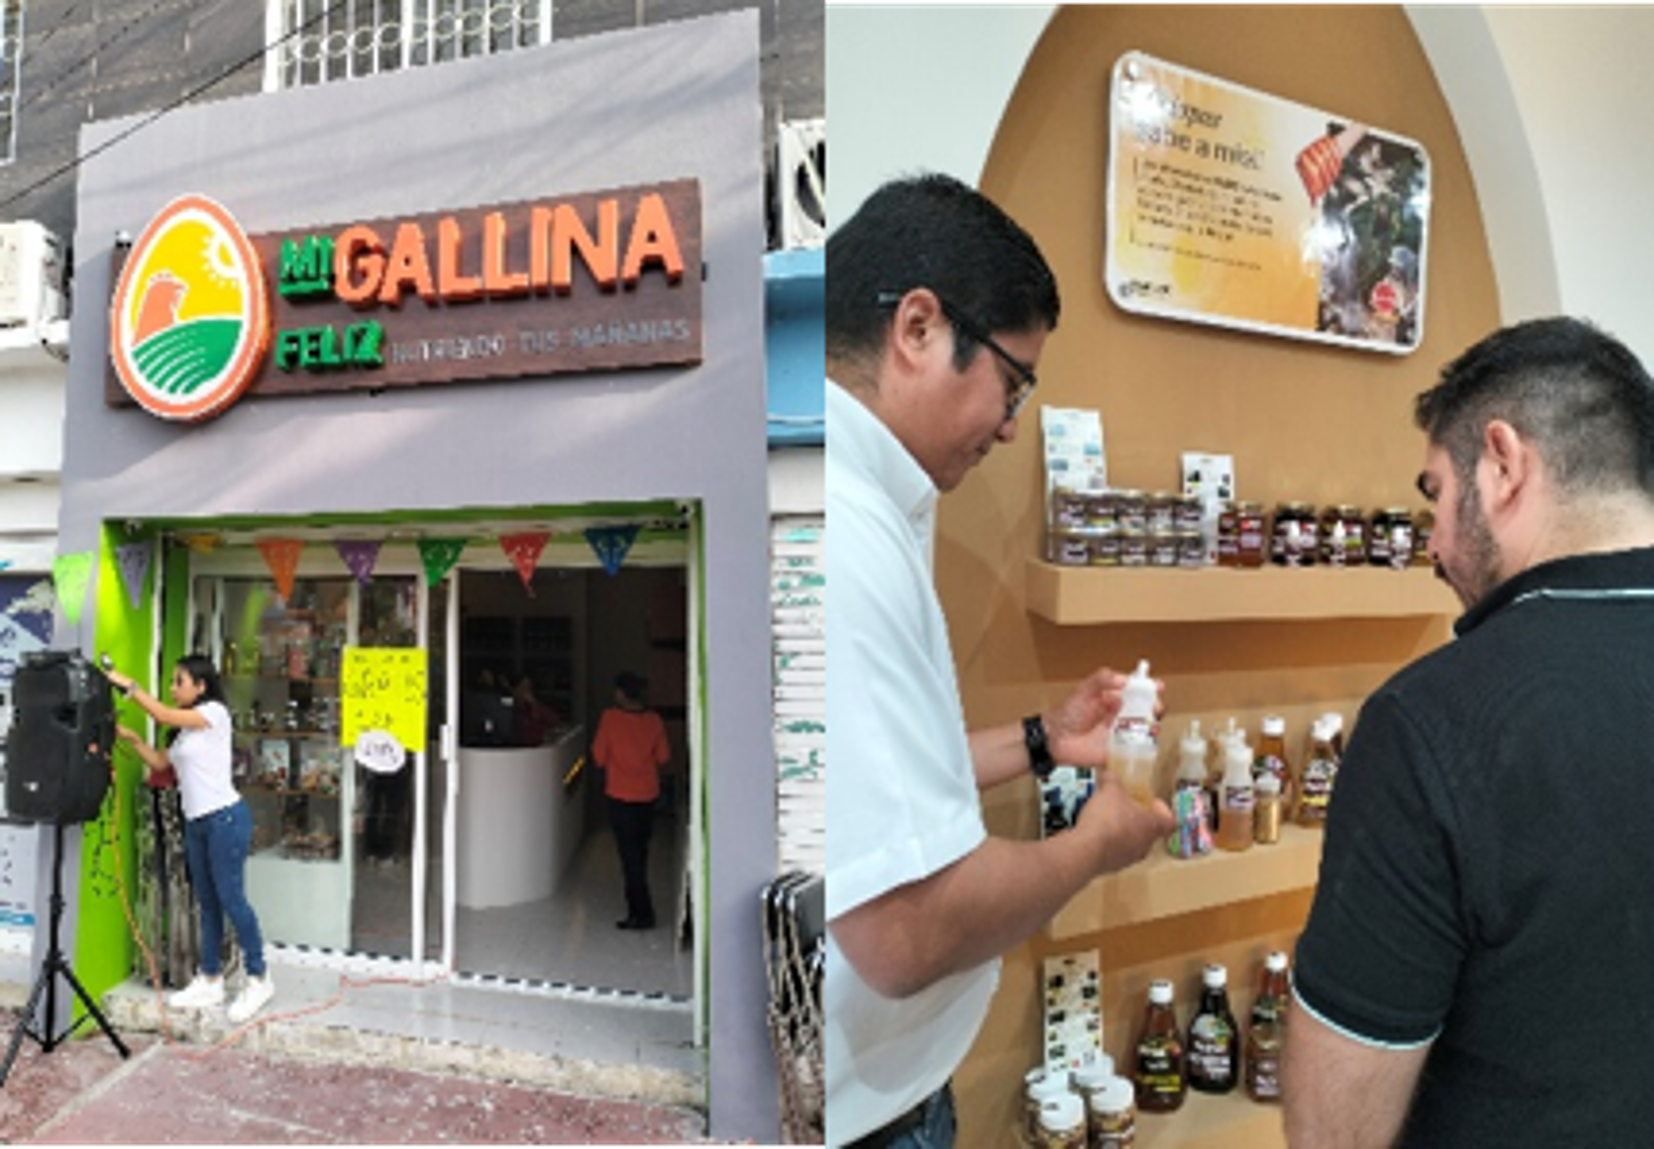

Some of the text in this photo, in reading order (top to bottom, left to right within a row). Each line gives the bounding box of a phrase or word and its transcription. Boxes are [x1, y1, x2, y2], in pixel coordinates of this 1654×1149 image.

[279, 193, 685, 306] MI GALLINA
[275, 319, 384, 371] FELIZ
